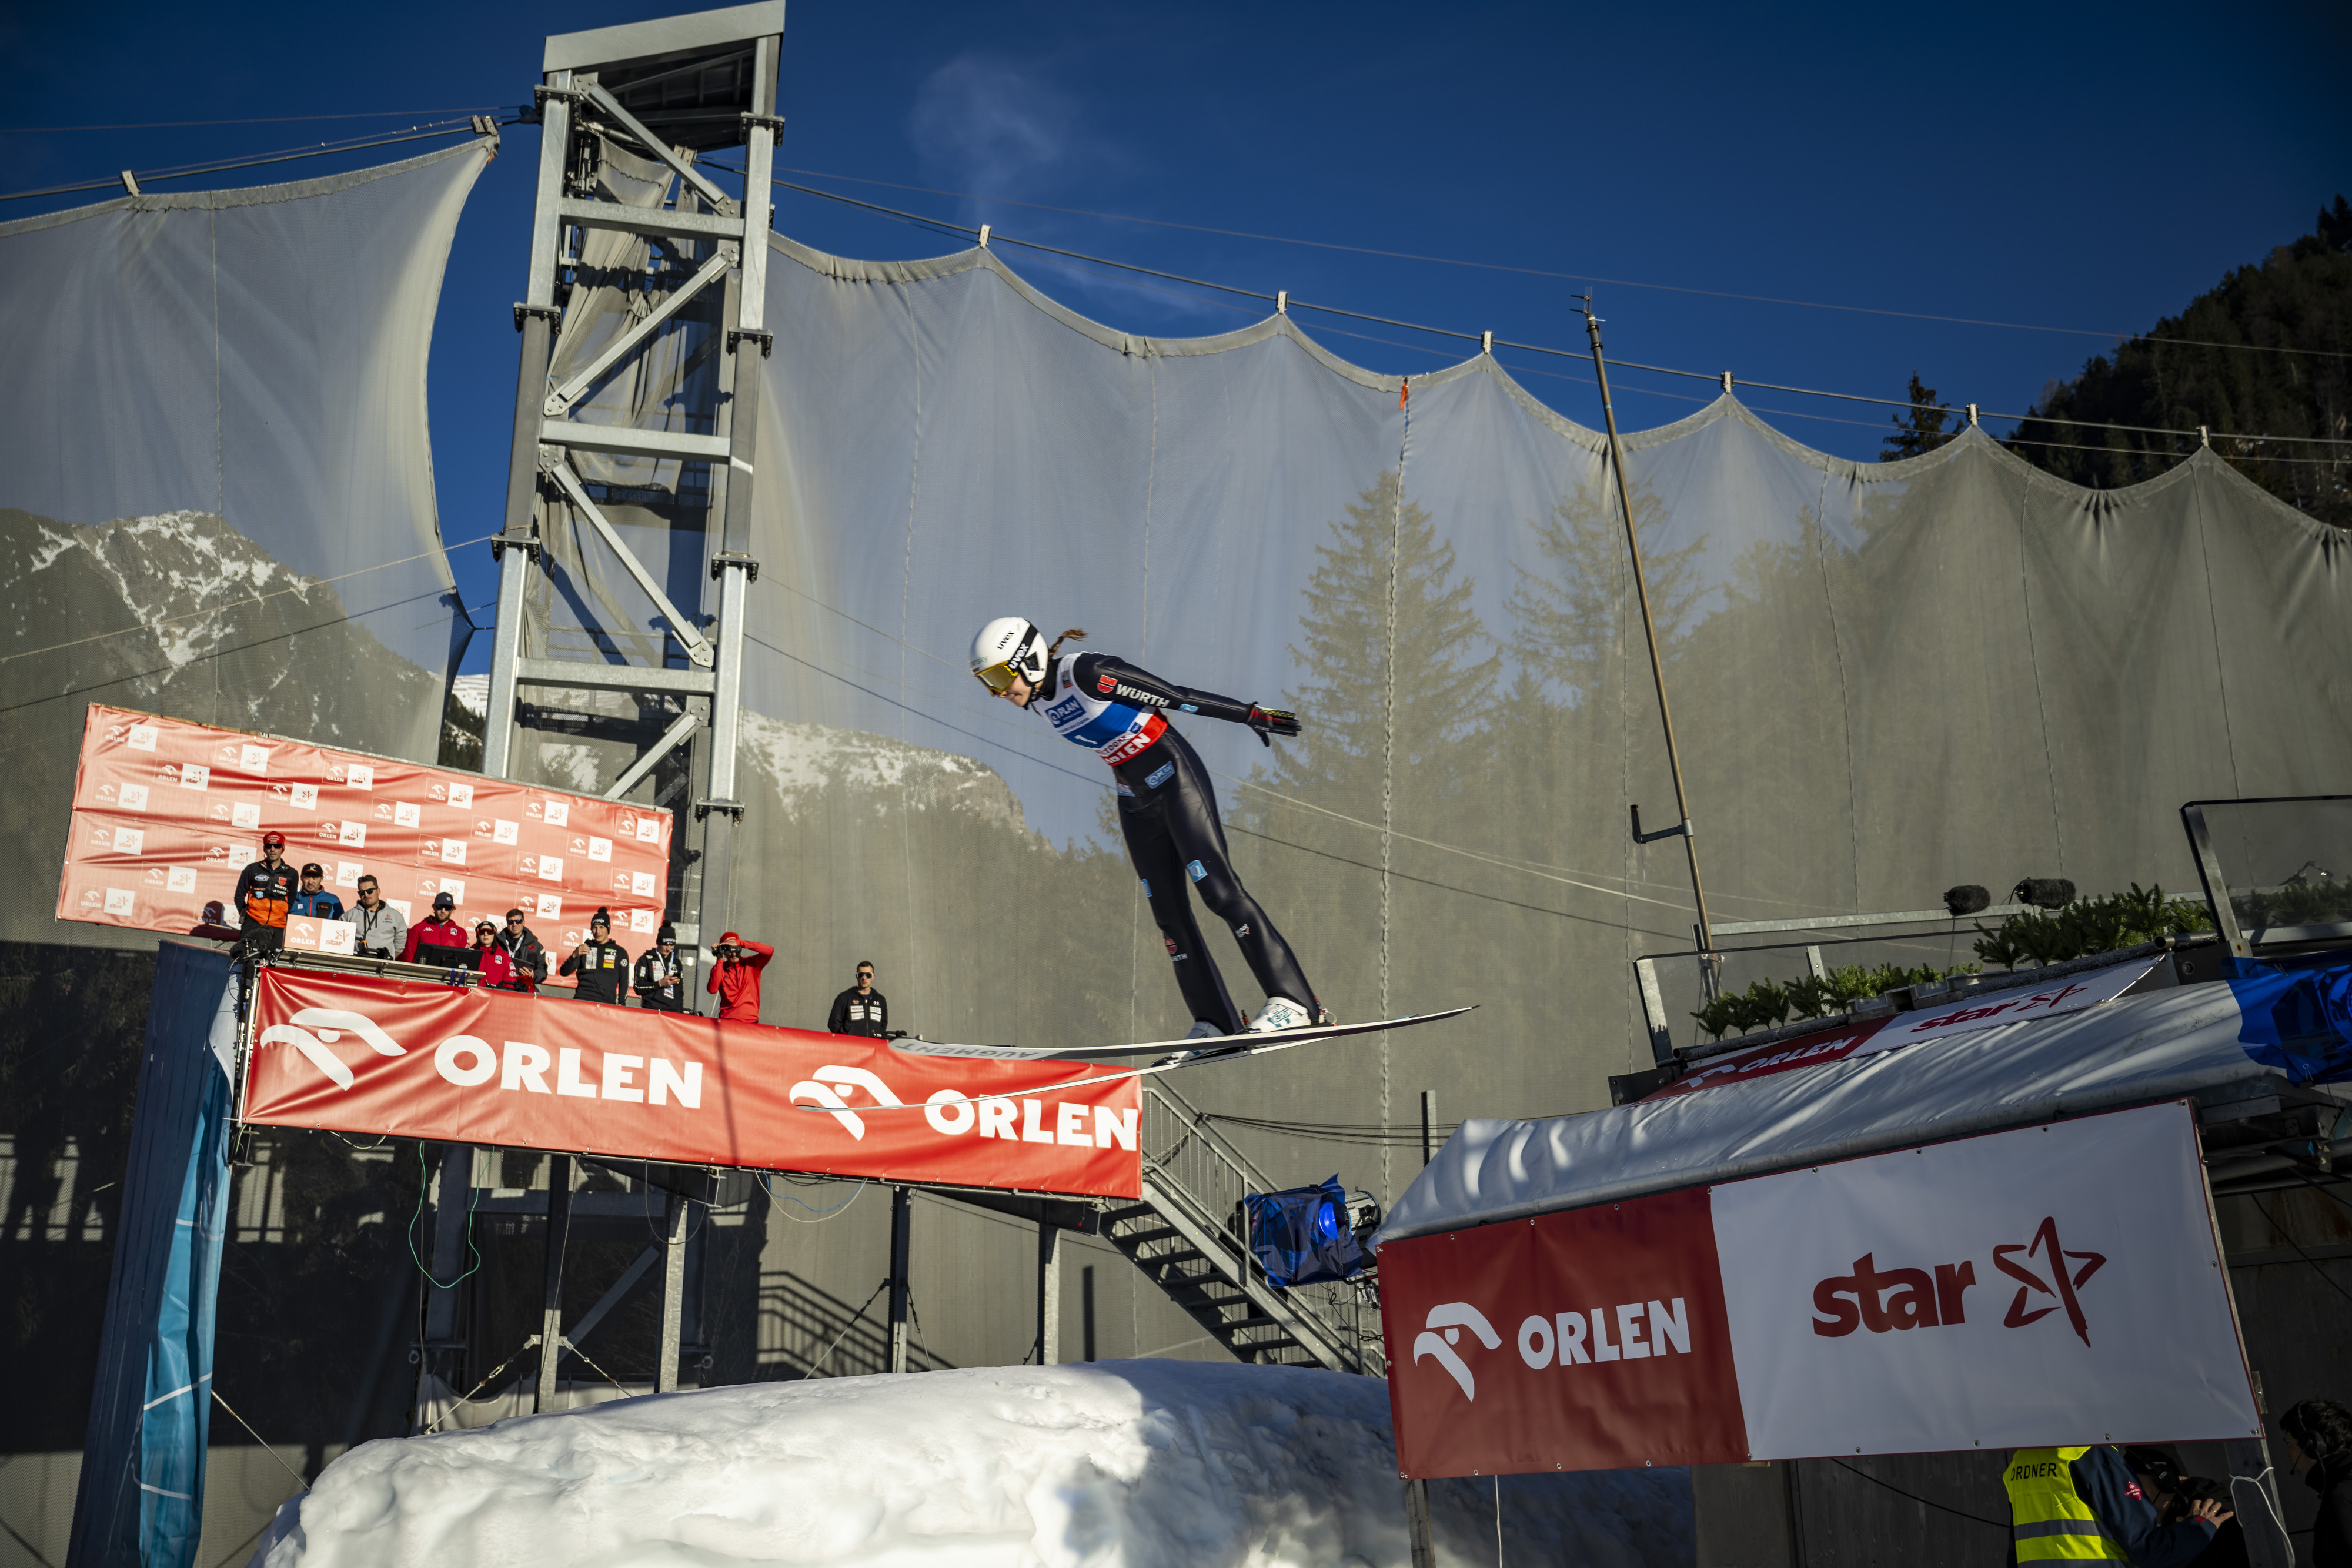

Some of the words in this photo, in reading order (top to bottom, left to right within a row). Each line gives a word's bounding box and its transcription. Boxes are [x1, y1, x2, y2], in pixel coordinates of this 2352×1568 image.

[997, 631, 1014, 649] uvex
[1008, 643, 1030, 670] uvex
[1058, 700, 1080, 717] PLAN
[290, 937, 315, 945] ORLEN
[1744, 1035, 1858, 1070] ORLEN
[1909, 1001, 2022, 1033] star
[897, 1043, 1039, 1059] AUGMENT
[434, 1035, 703, 1109] ORLEN
[924, 1088, 1139, 1152] ORLEN
[1518, 1297, 1692, 1370] ORLEN
[1812, 1252, 1976, 1338] star
